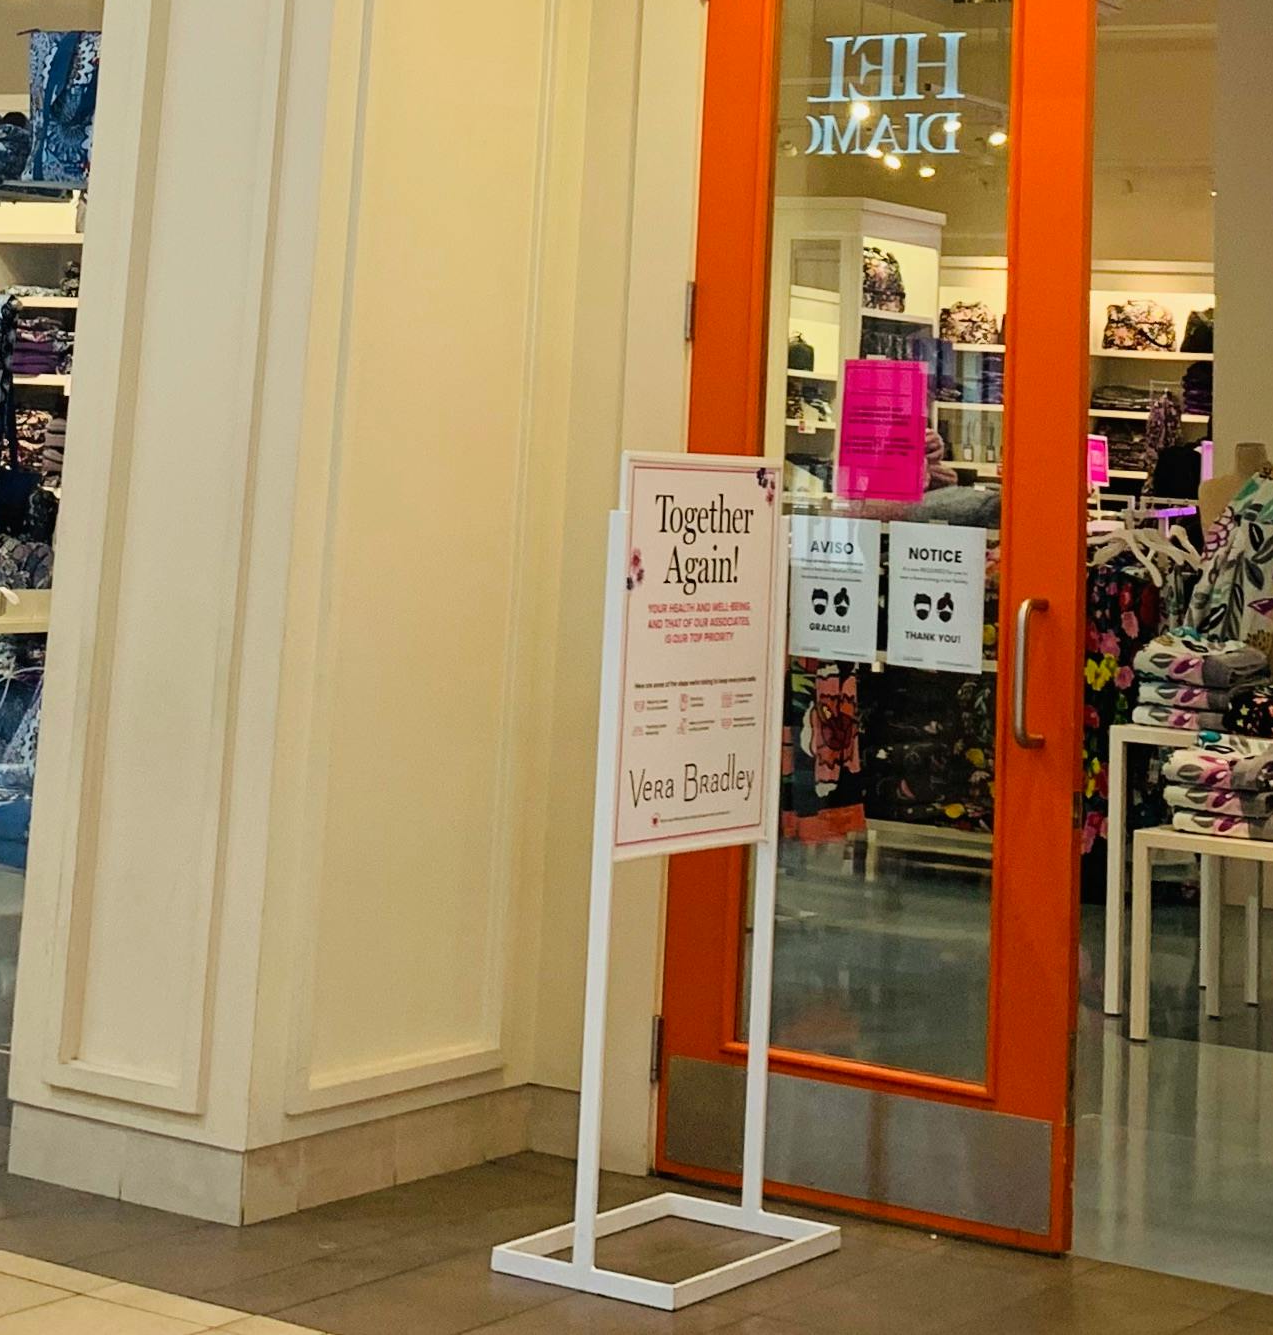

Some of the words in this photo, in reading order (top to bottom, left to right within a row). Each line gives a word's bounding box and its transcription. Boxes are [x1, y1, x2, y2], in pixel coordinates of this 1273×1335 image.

[655, 494, 754, 545] Together
[810, 540, 854, 555] AVISO
[908, 547, 963, 563] NOTICE
[663, 545, 739, 595] Again!
[809, 623, 850, 634] GRACIAS!
[904, 630, 936, 642] THANK
[938, 633, 961, 644] YOU!
